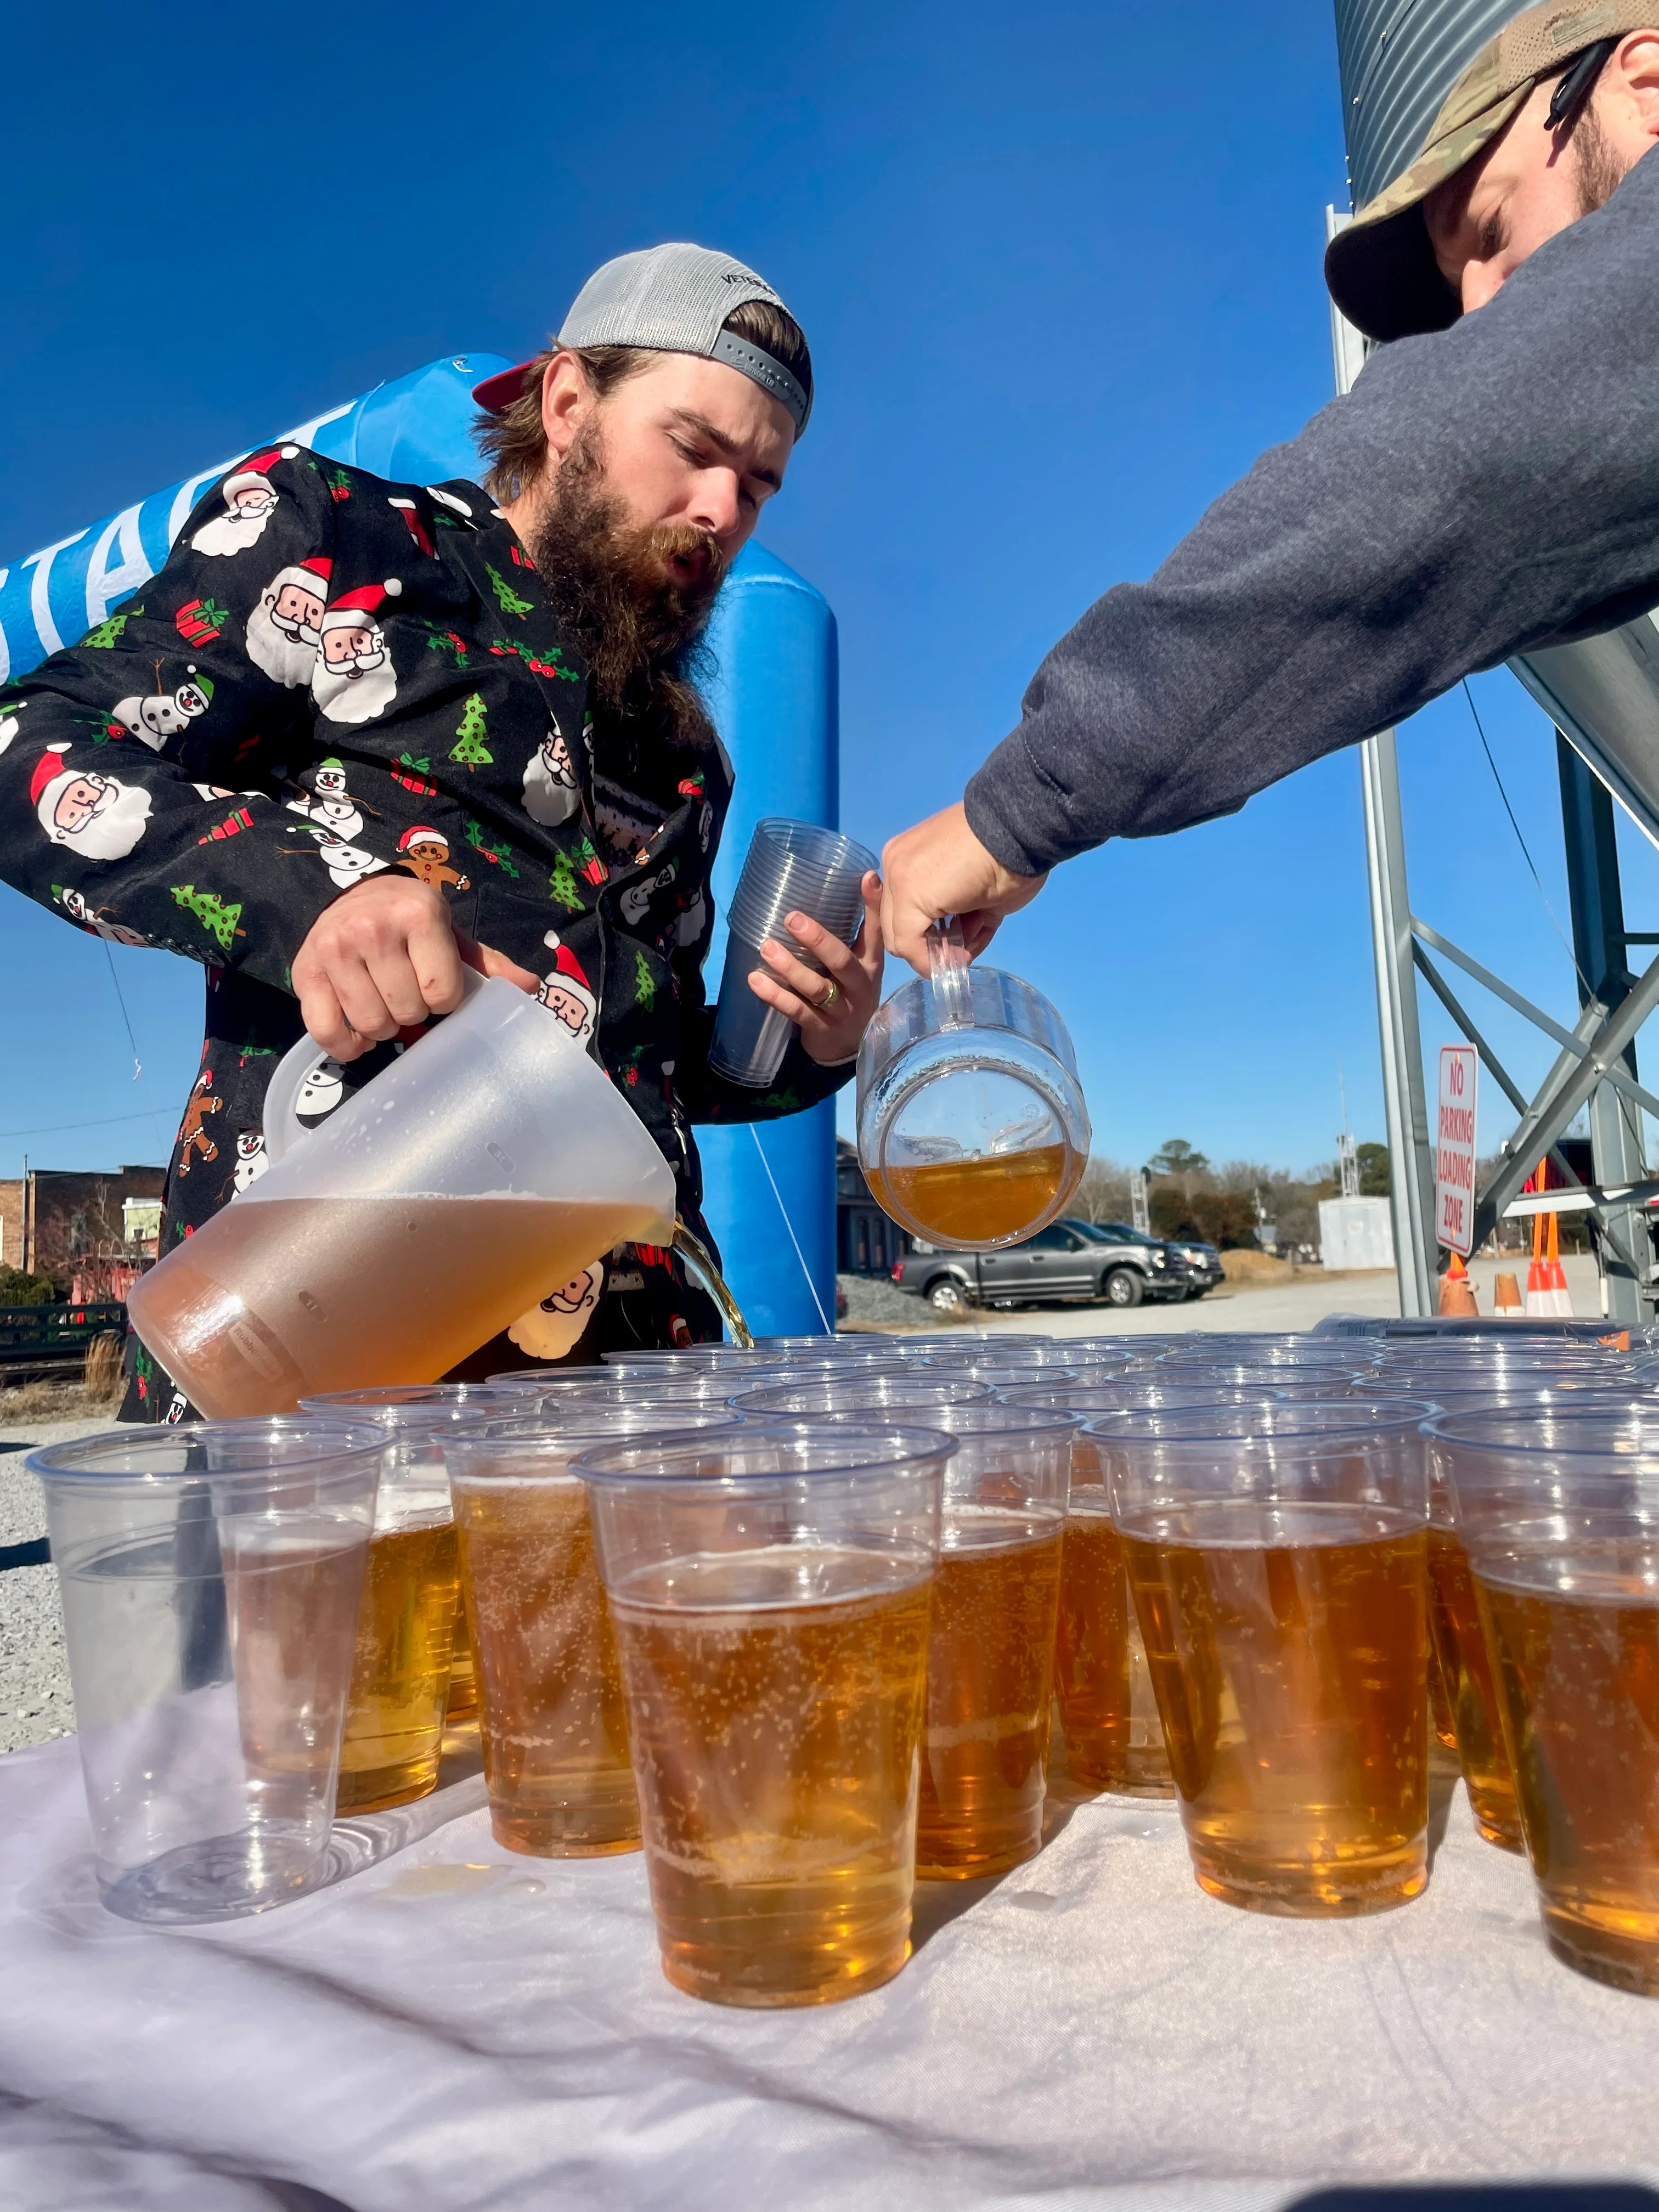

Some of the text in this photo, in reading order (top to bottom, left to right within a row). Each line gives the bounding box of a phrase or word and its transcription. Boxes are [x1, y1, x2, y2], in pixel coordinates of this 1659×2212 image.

[1450, 1062, 1464, 1096] NO
[1440, 1105, 1473, 1146] PARKING
[1439, 1148, 1471, 1190] LOADING
[1444, 1193, 1463, 1234] ZONE
[234, 1327, 275, 1375] Rubber
